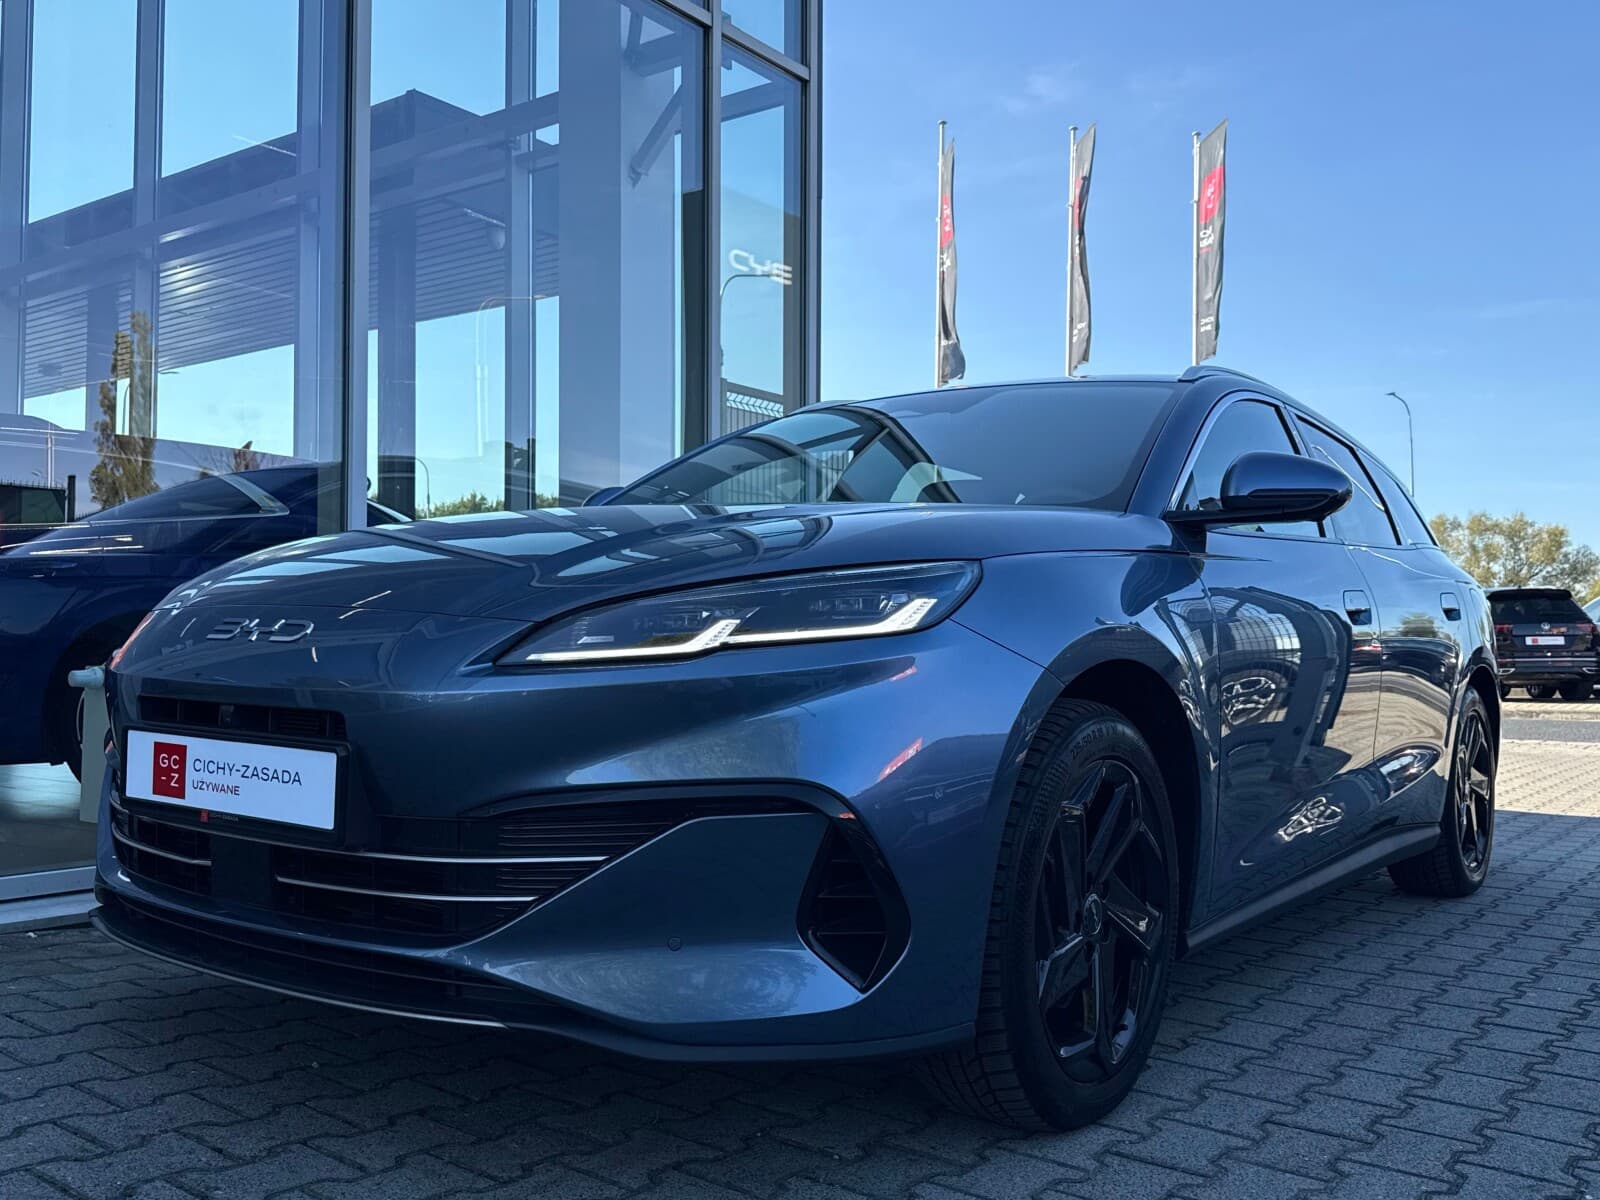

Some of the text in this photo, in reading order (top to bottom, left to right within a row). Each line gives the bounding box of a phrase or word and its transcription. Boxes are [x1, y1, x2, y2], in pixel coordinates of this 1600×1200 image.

[206, 617, 315, 643] BYD
[159, 753, 180, 770] GC
[192, 758, 303, 786] CICHY-ZASADA
[192, 779, 241, 797] UŻYWANE
